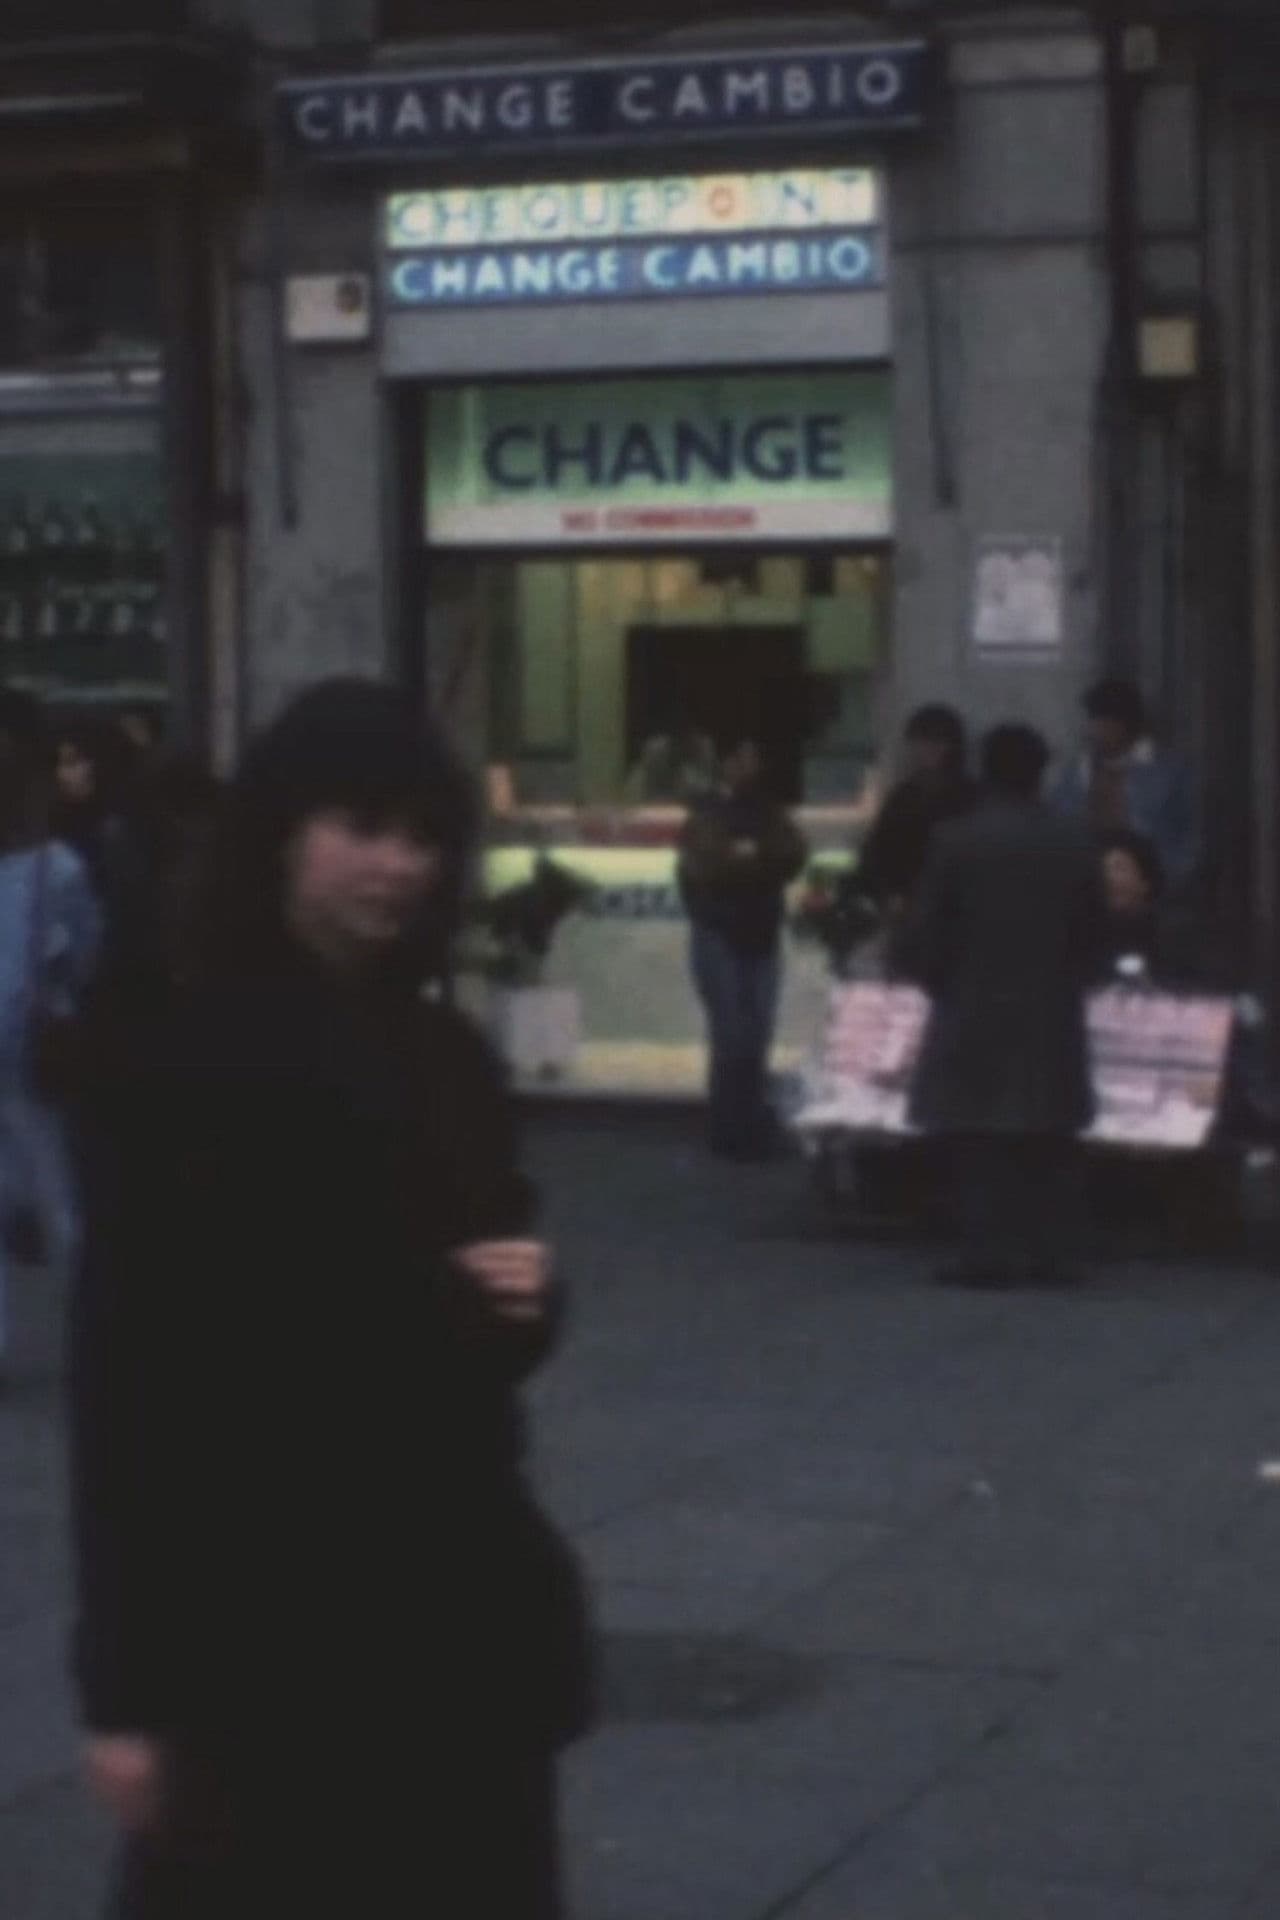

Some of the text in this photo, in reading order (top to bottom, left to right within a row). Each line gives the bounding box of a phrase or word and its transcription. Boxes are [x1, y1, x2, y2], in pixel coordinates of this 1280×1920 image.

[298, 60, 899, 139] CHANGE CAMBIO
[391, 236, 871, 303] CHANGE CAMBIO
[482, 414, 845, 489] CHANGE
